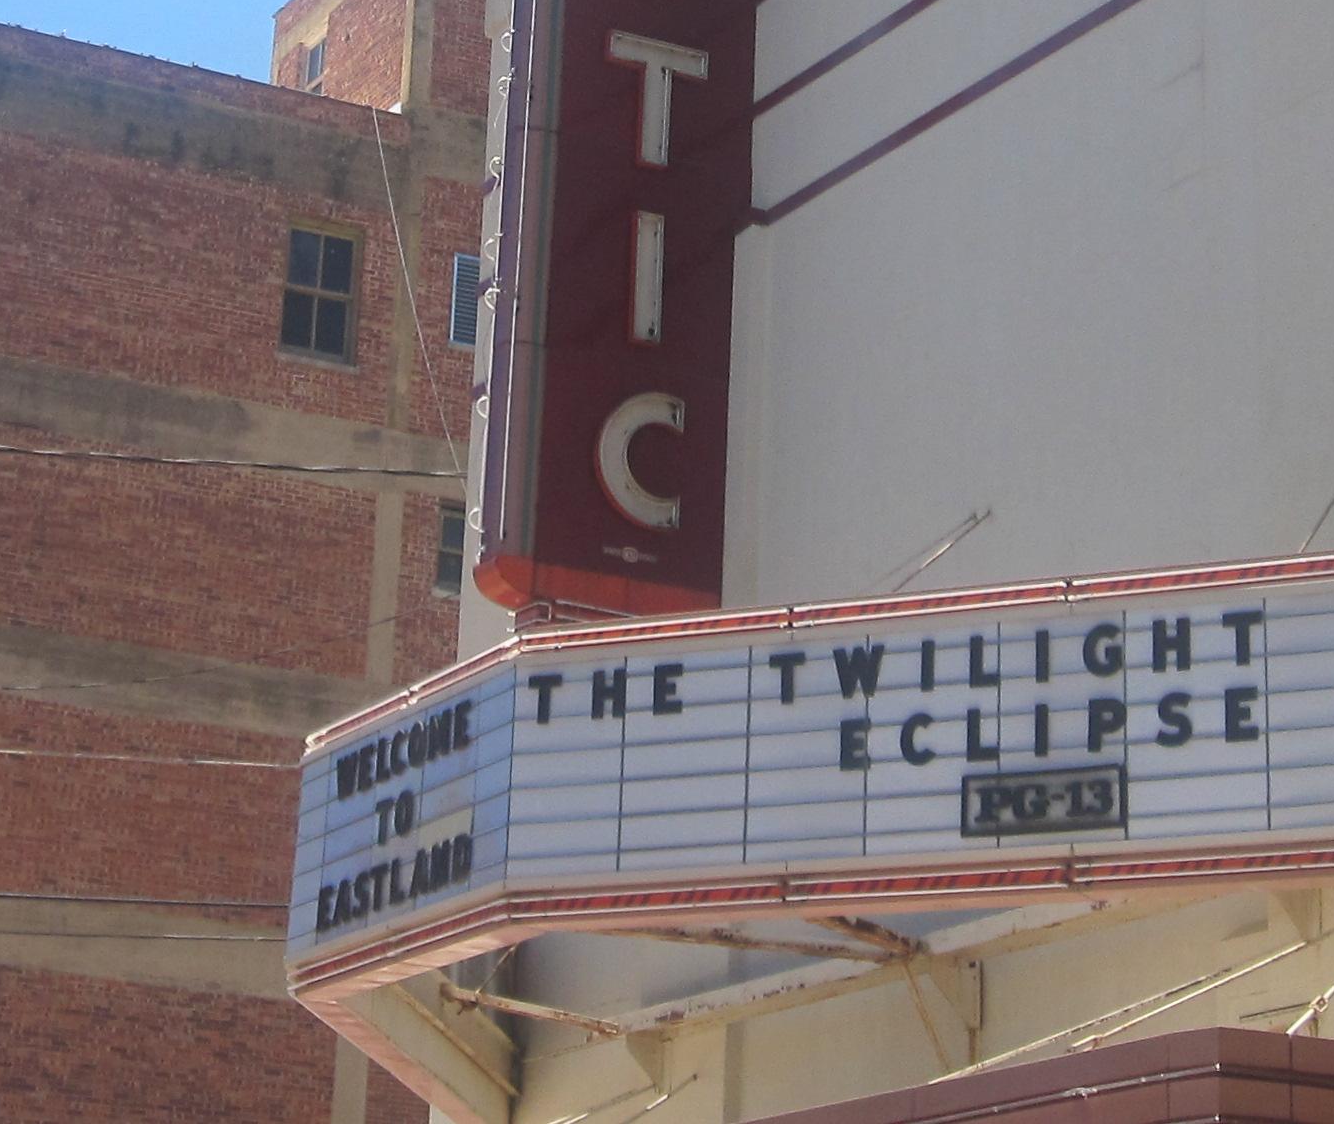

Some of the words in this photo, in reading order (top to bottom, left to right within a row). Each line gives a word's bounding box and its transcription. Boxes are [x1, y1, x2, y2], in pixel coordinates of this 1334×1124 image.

[528, 663, 684, 725] THE
[769, 607, 1263, 705] TWILIGHT
[336, 698, 473, 801] WELCOME
[840, 686, 1260, 771] ECLIPSE
[376, 789, 414, 845] TO
[974, 778, 1115, 824] PG-13
[317, 833, 473, 931] EASTLAND
